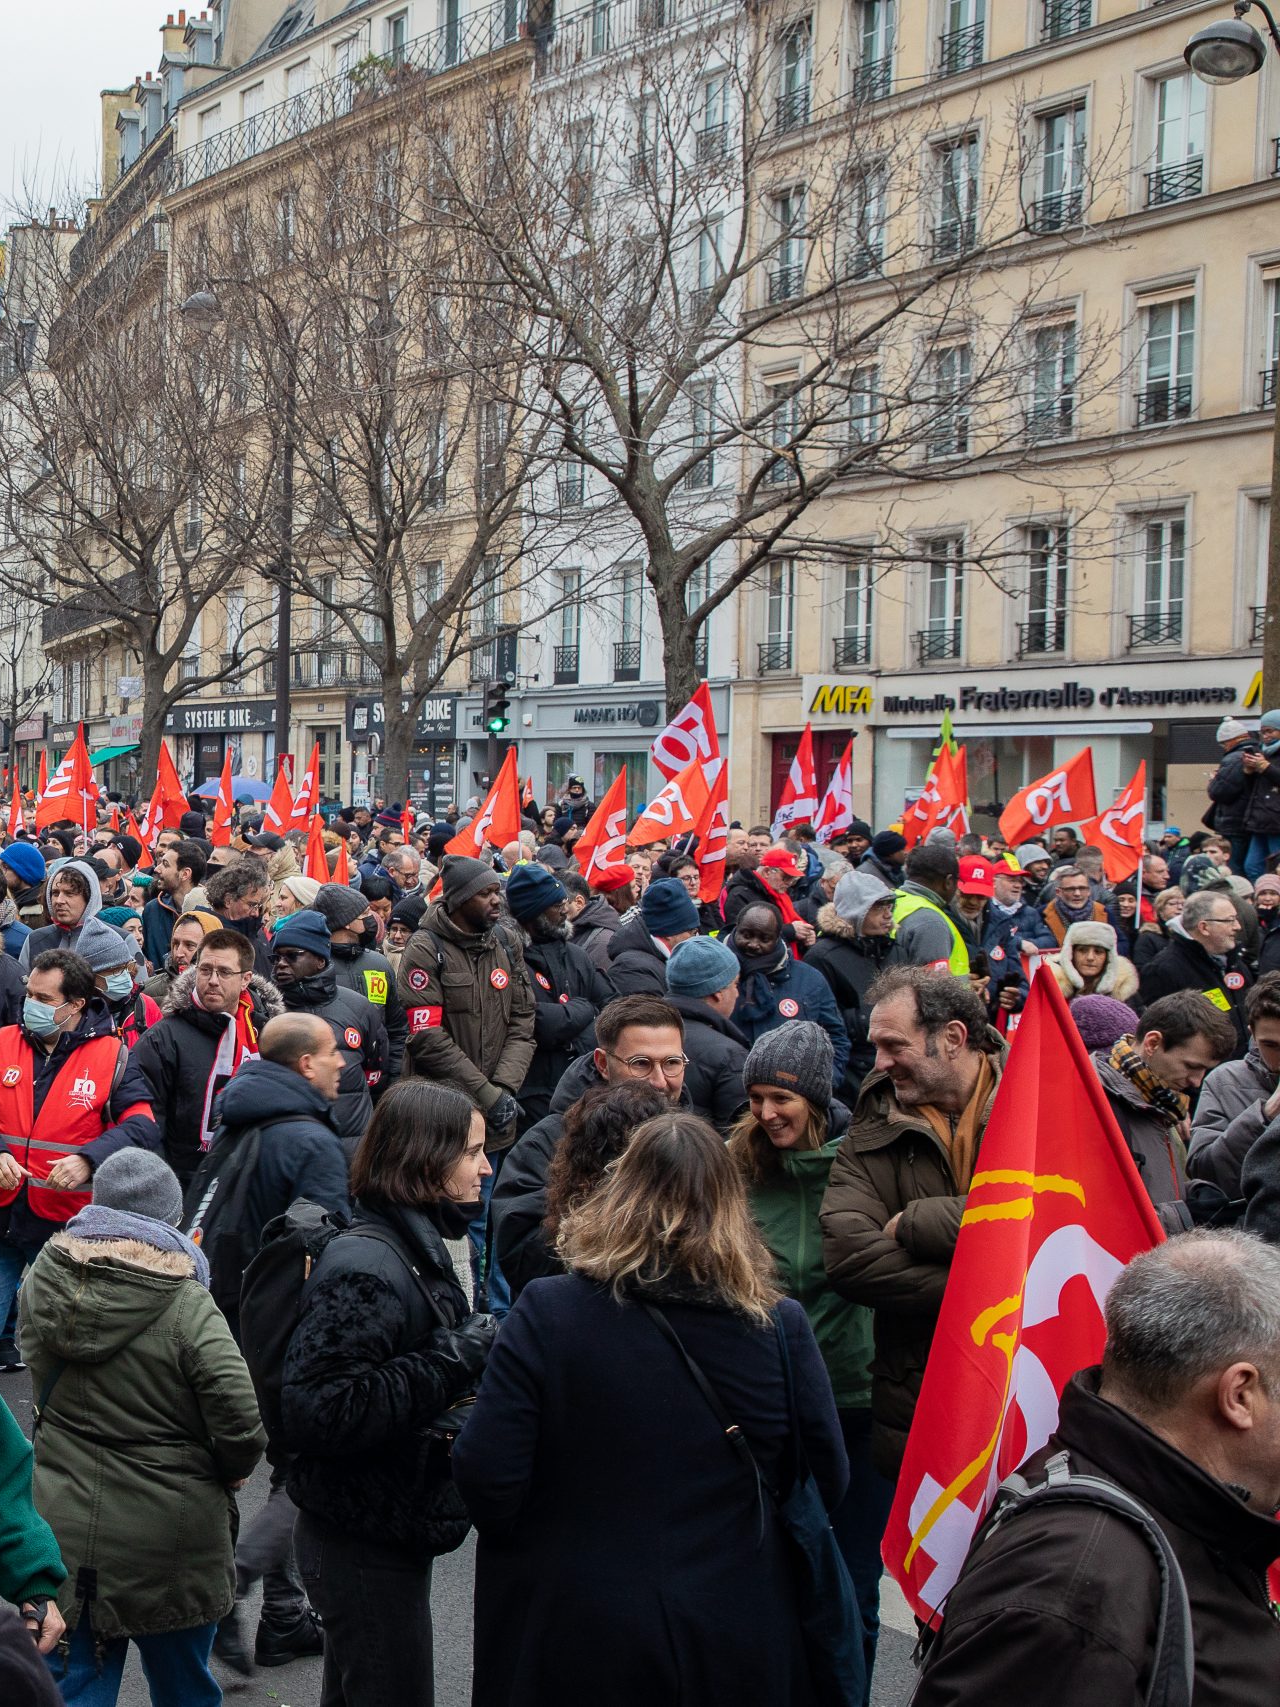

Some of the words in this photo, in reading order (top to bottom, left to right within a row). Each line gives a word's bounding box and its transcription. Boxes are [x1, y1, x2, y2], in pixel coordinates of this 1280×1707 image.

[810, 684, 875, 713] MFA
[883, 693, 956, 714] Mutuelle
[959, 682, 1095, 711] Fraternelle
[1099, 686, 1237, 706] d'Assurances
[426, 699, 451, 720] BIKE
[574, 707, 615, 723] MARAIS
[185, 709, 226, 728] SYSTEME
[229, 708, 251, 727] BIKE
[202, 745, 218, 753] ATELIER
[371, 976, 385, 994] FO
[492, 971, 508, 986] FO
[1228, 976, 1240, 987] FO
[413, 1009, 430, 1025] FO
[348, 1031, 360, 1045] FO
[3, 1069, 20, 1083] FO
[74, 1078, 96, 1095] FO
